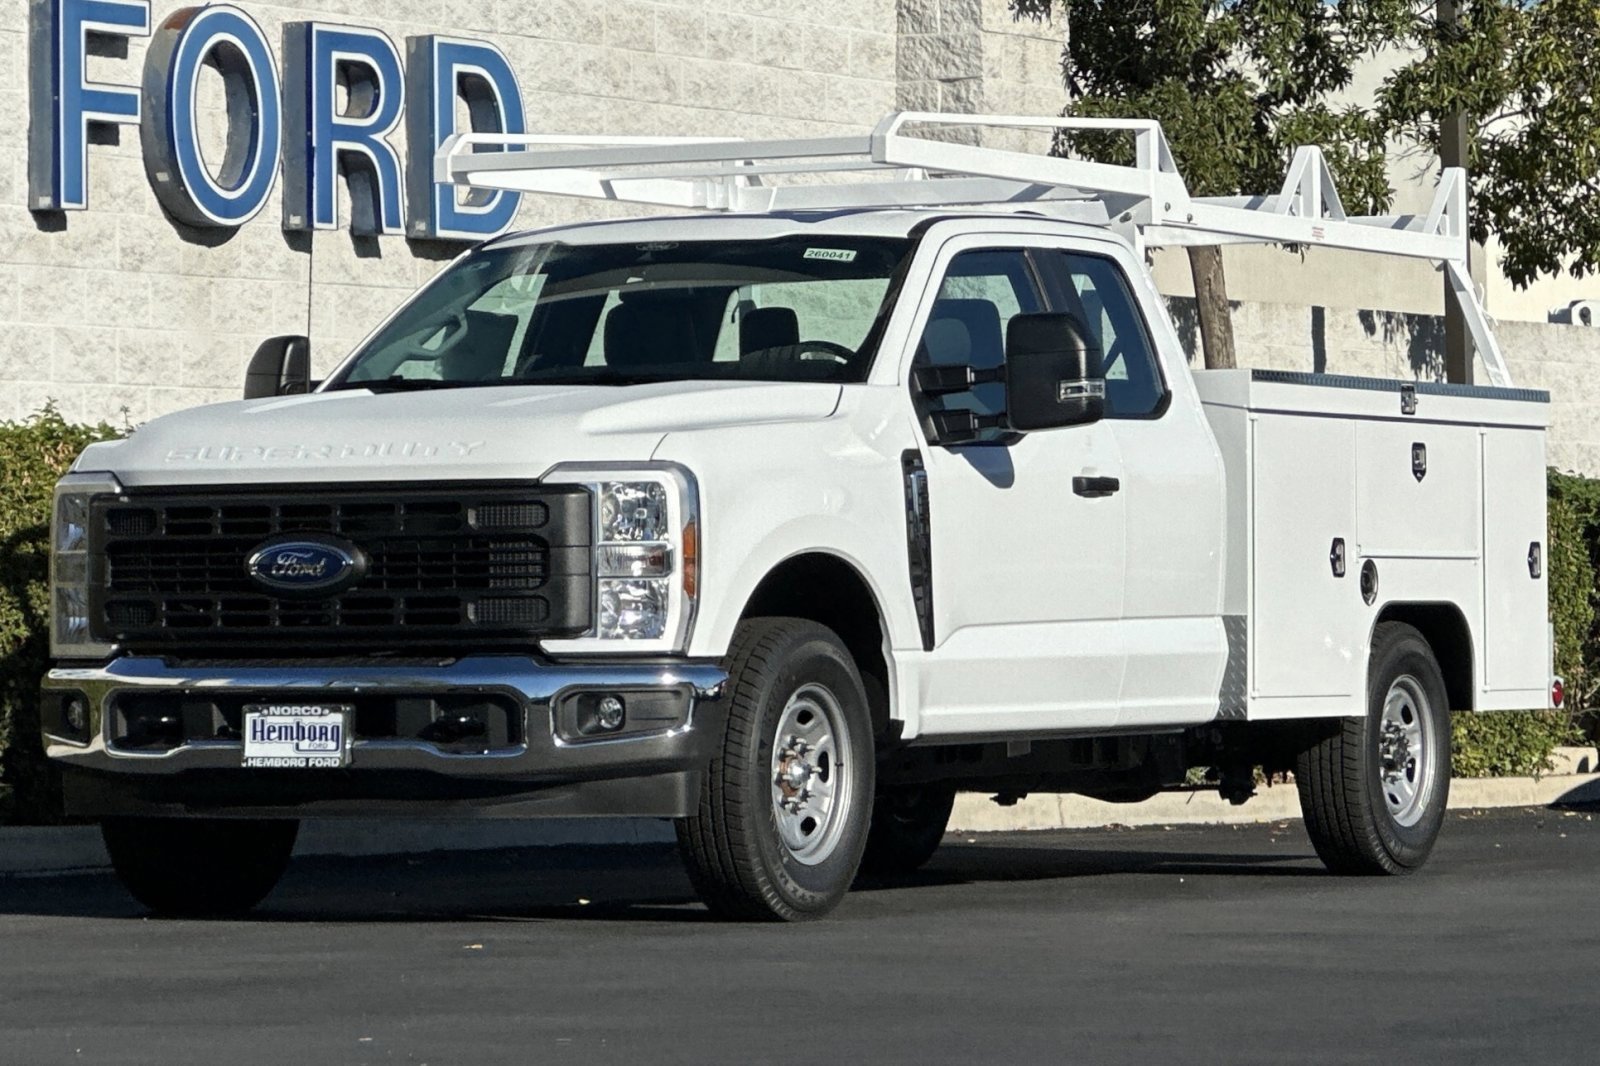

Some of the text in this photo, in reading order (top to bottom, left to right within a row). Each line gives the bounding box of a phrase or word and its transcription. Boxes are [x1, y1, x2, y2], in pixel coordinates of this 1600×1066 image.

[29, 0, 528, 238] FORD
[806, 250, 851, 259] 260041
[271, 552, 327, 576] Ford
[269, 706, 322, 715] NORCO
[308, 742, 328, 750] FORD
[247, 757, 340, 767] HEMBORG FORD
